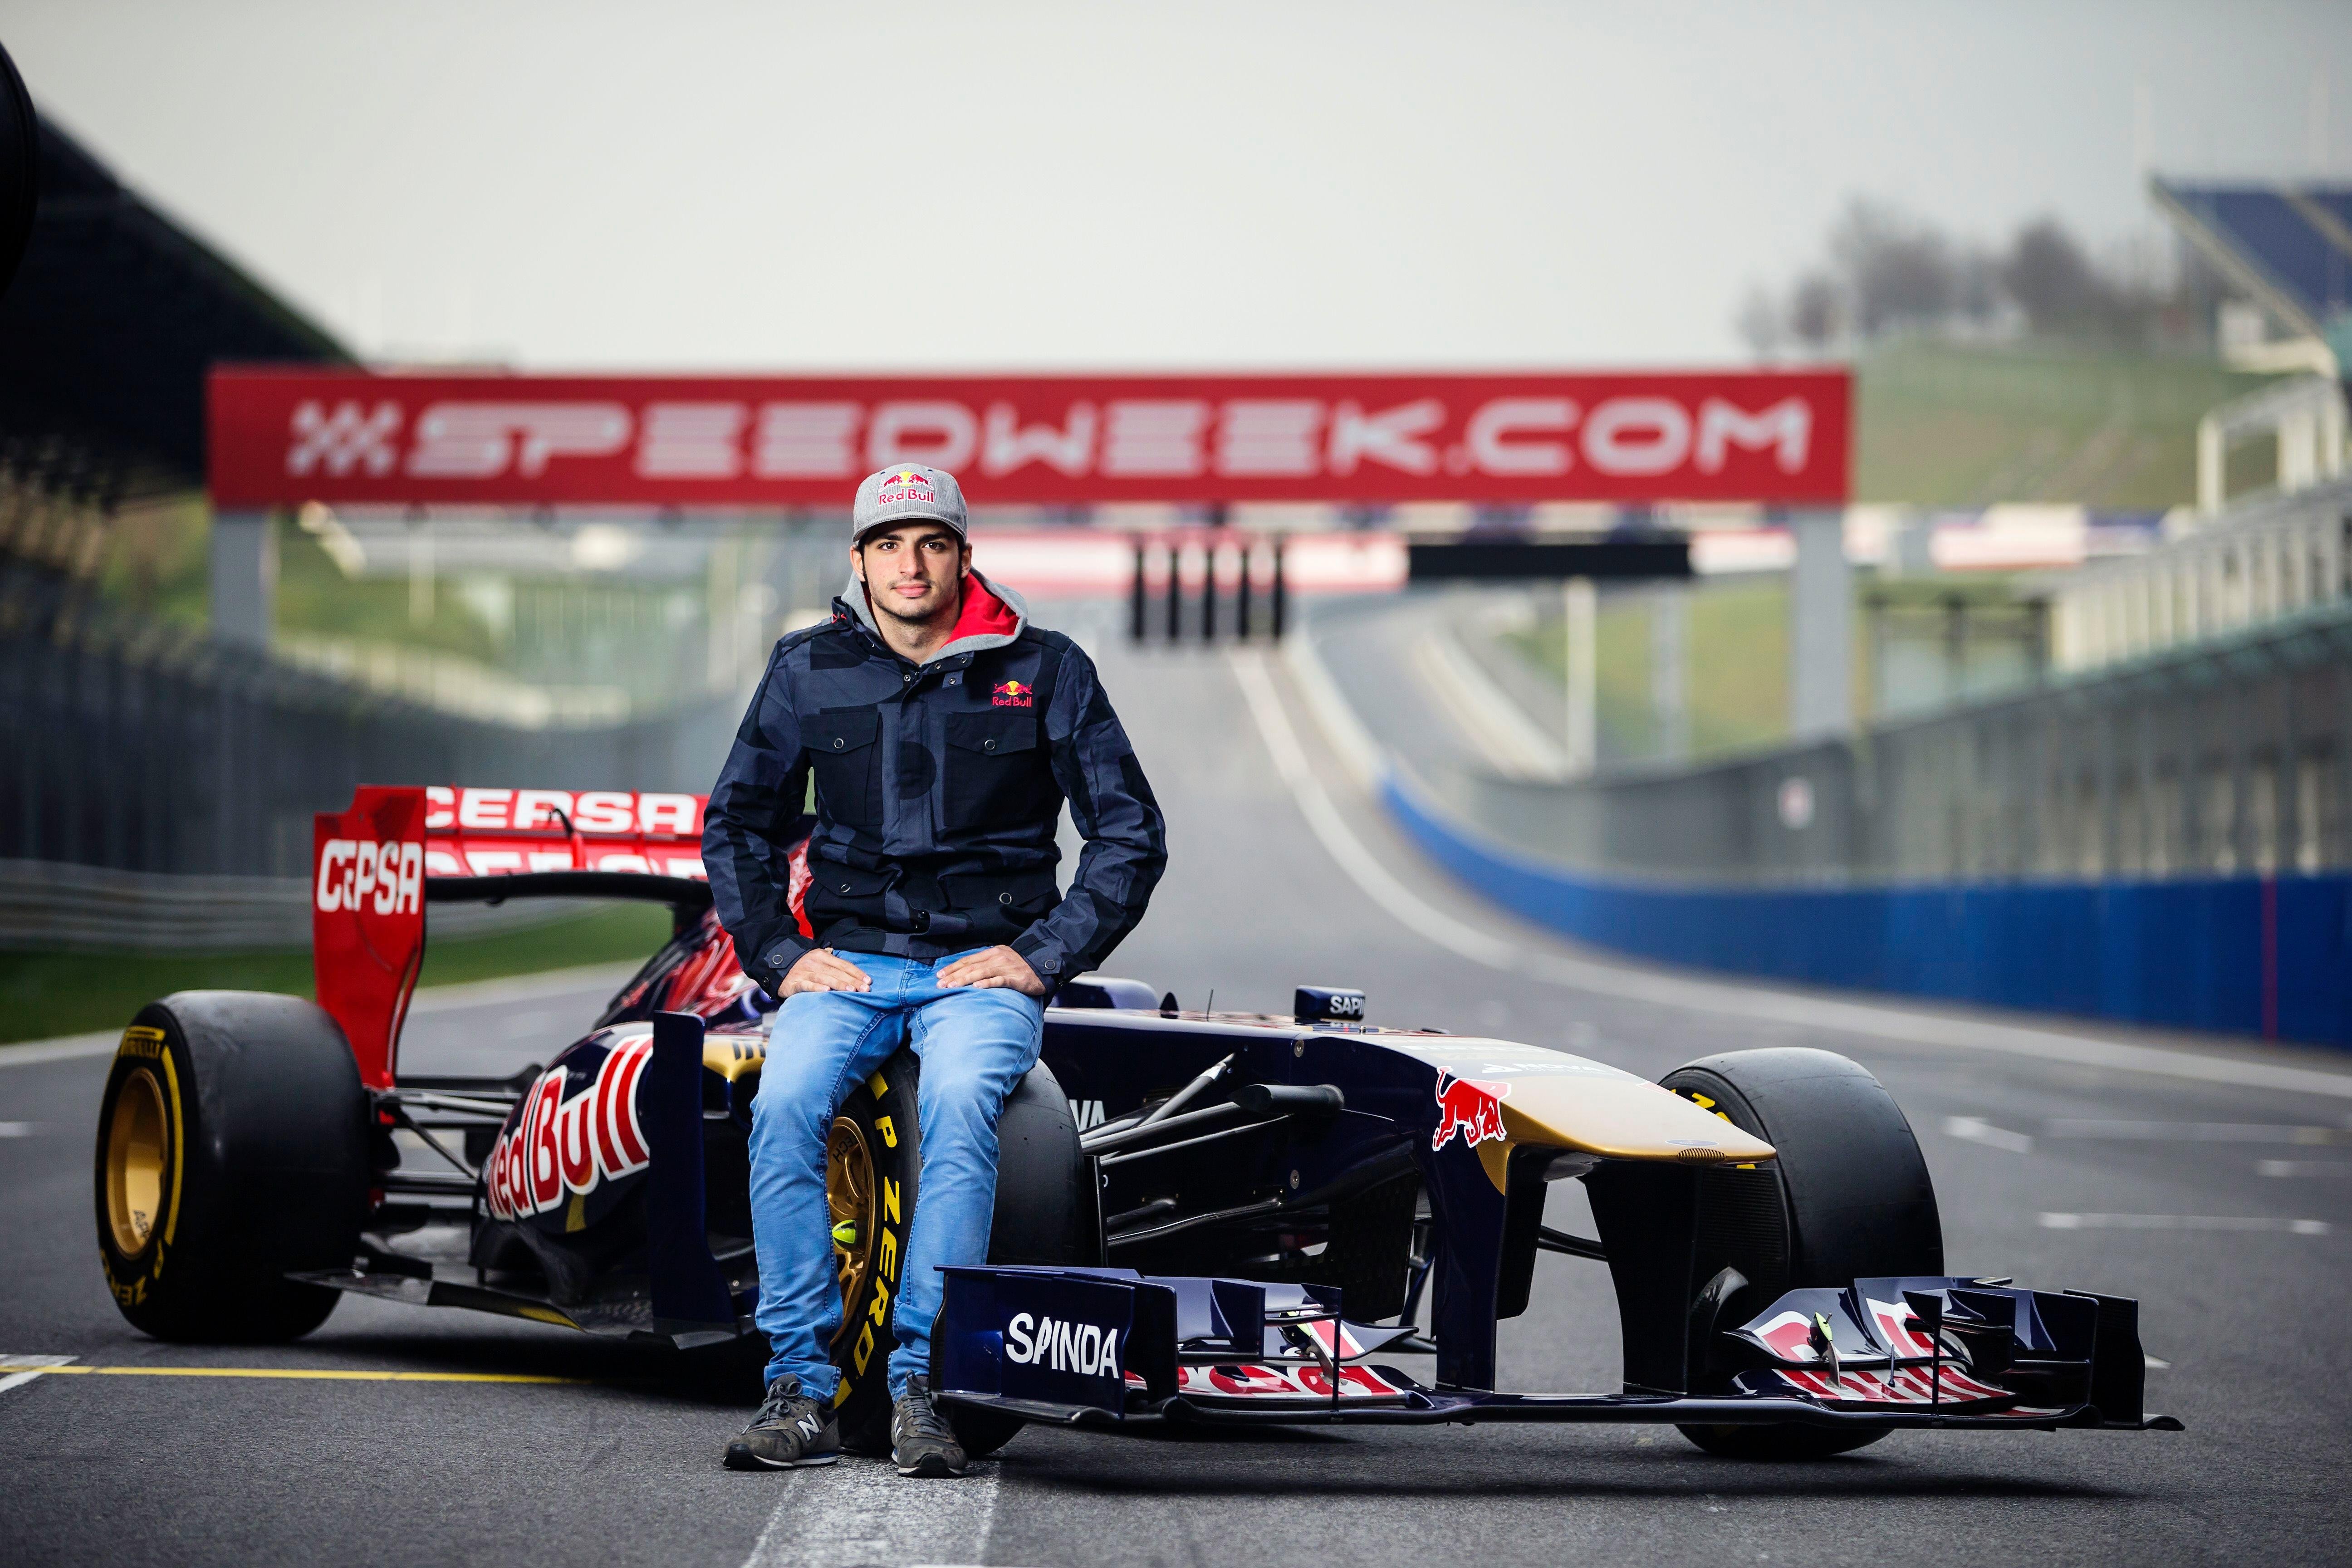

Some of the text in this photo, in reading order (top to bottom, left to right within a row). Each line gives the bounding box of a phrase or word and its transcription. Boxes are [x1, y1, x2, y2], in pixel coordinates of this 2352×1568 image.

[402, 395, 1813, 480] SPEEDWEEK.COM
[878, 488, 935, 505] Red Bull
[992, 696, 1032, 707] Red Bull
[531, 1034, 653, 1214] Bull
[854, 1115, 901, 1377] P ZERO
